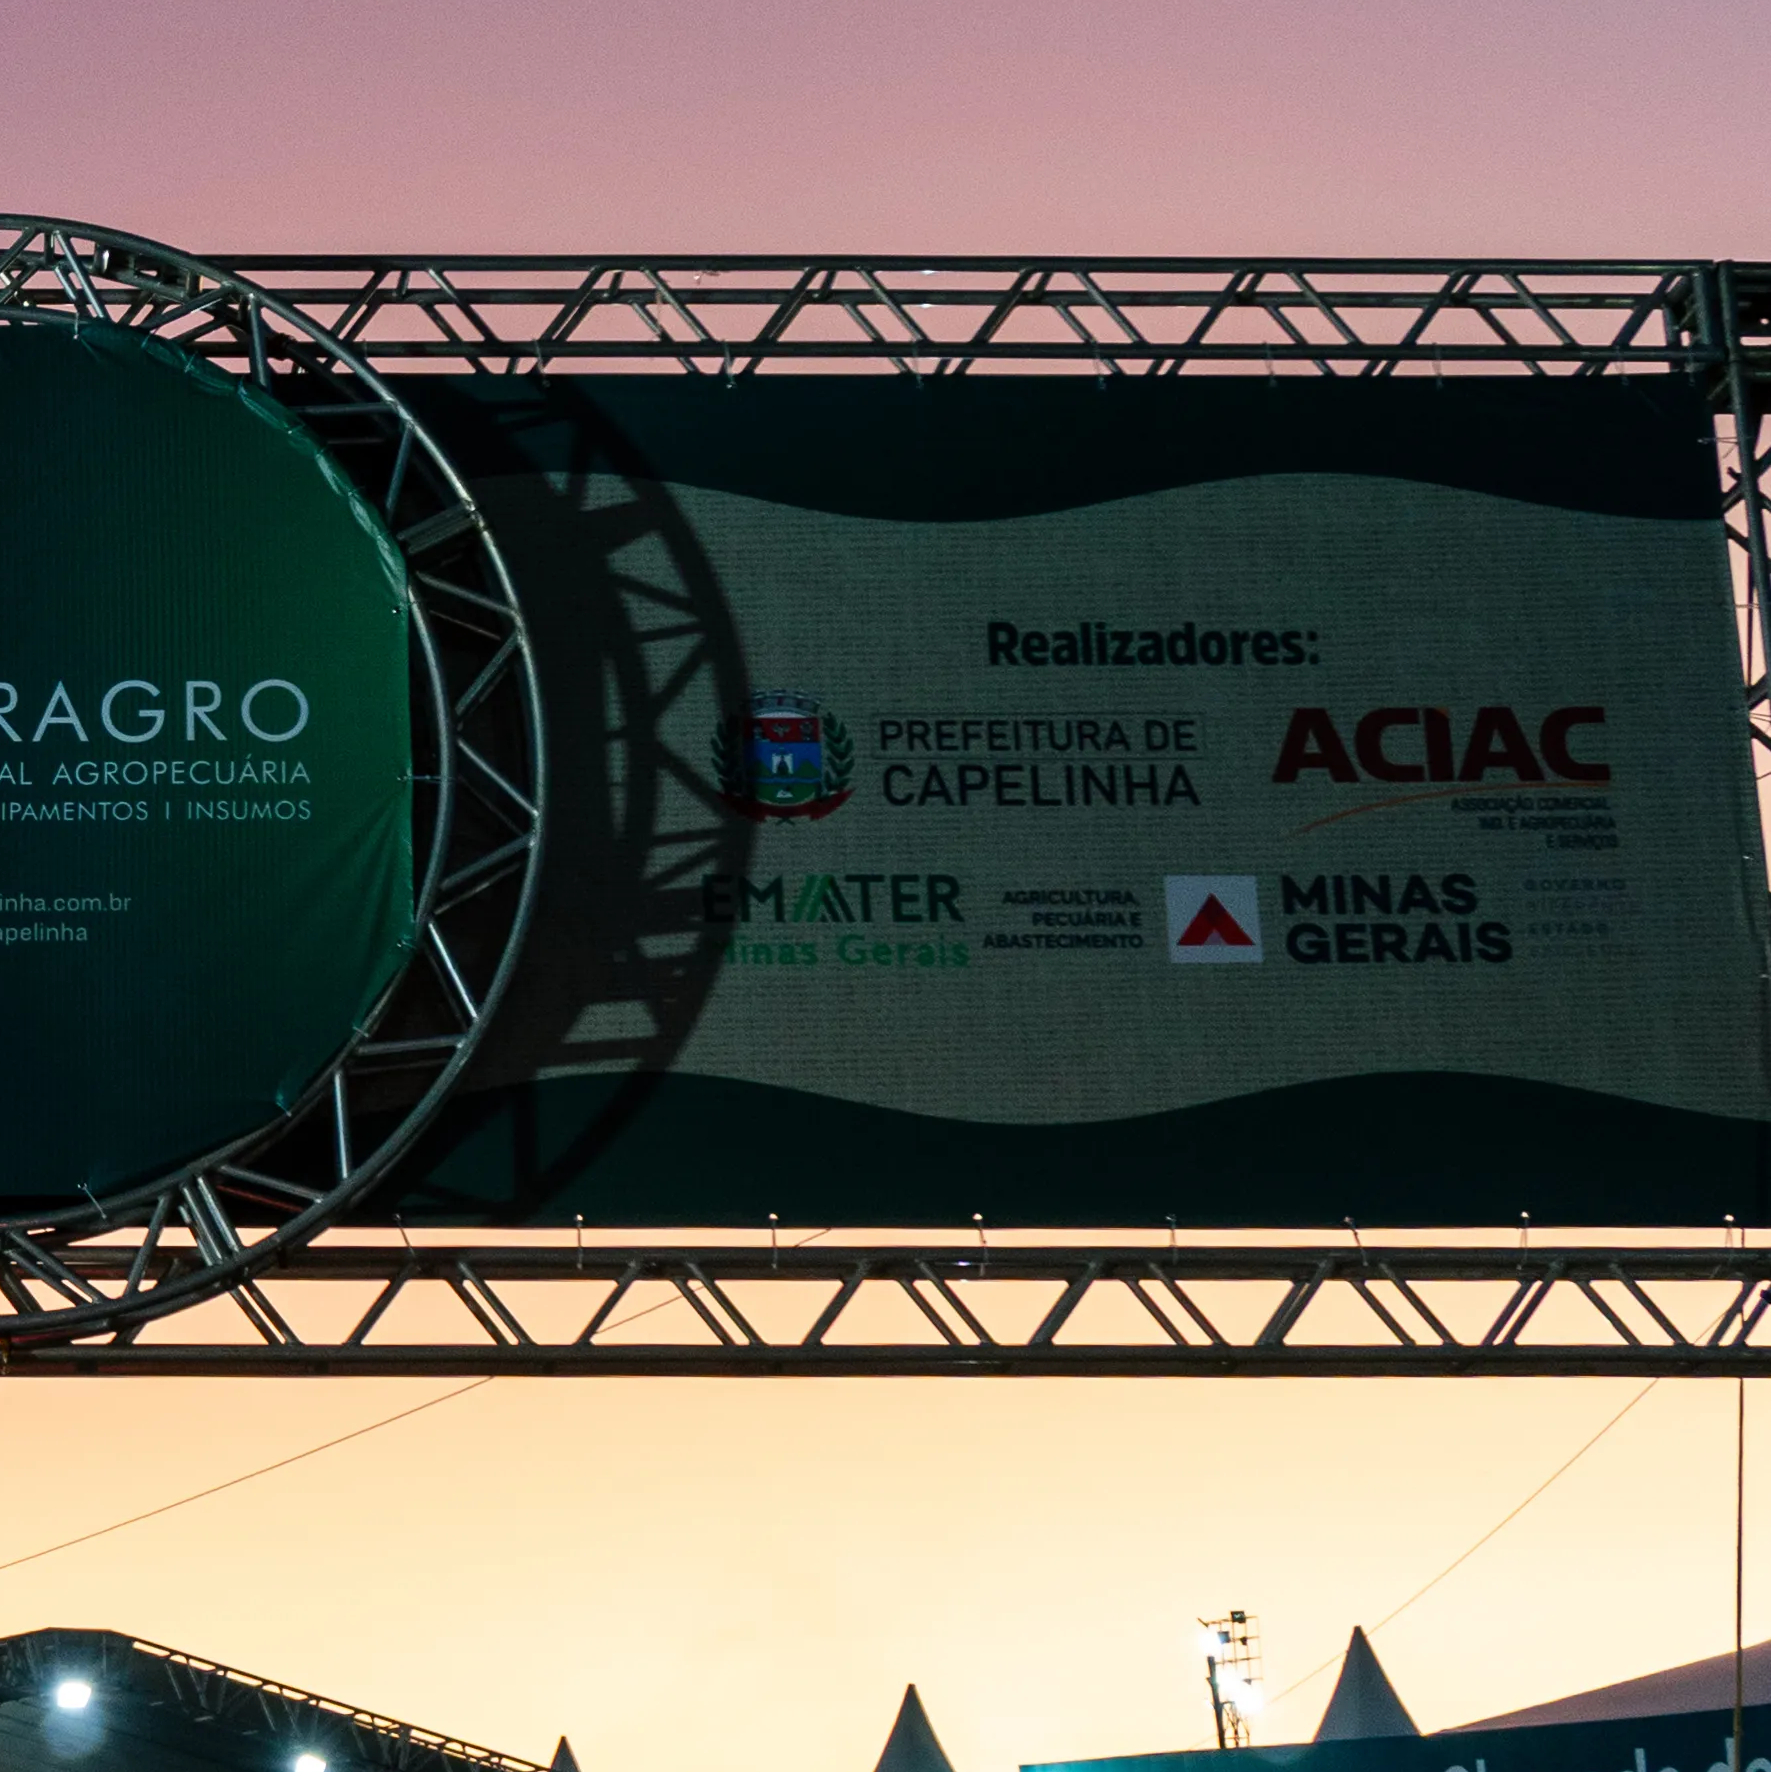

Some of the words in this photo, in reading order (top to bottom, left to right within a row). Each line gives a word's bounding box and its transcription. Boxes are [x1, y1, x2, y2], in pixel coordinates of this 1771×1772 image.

[987, 621, 1320, 666] Realizadores:
[879, 719, 1130, 752] PREFEITURA
[1145, 719, 1198, 752] DE
[1271, 706, 1611, 783] ACIAC
[52, 752, 312, 786] AGROPECUÁRIA
[883, 763, 1201, 807] CAPELINHA
[187, 799, 312, 822] INSUMOS
[700, 873, 965, 924] EMATER
[1281, 873, 1478, 915] MINAS
[1129, 911, 1142, 927] E
[837, 934, 970, 967] Gerais
[983, 933, 1144, 950] ABASTECIMENTO
[1286, 921, 1513, 964] GERAIS
